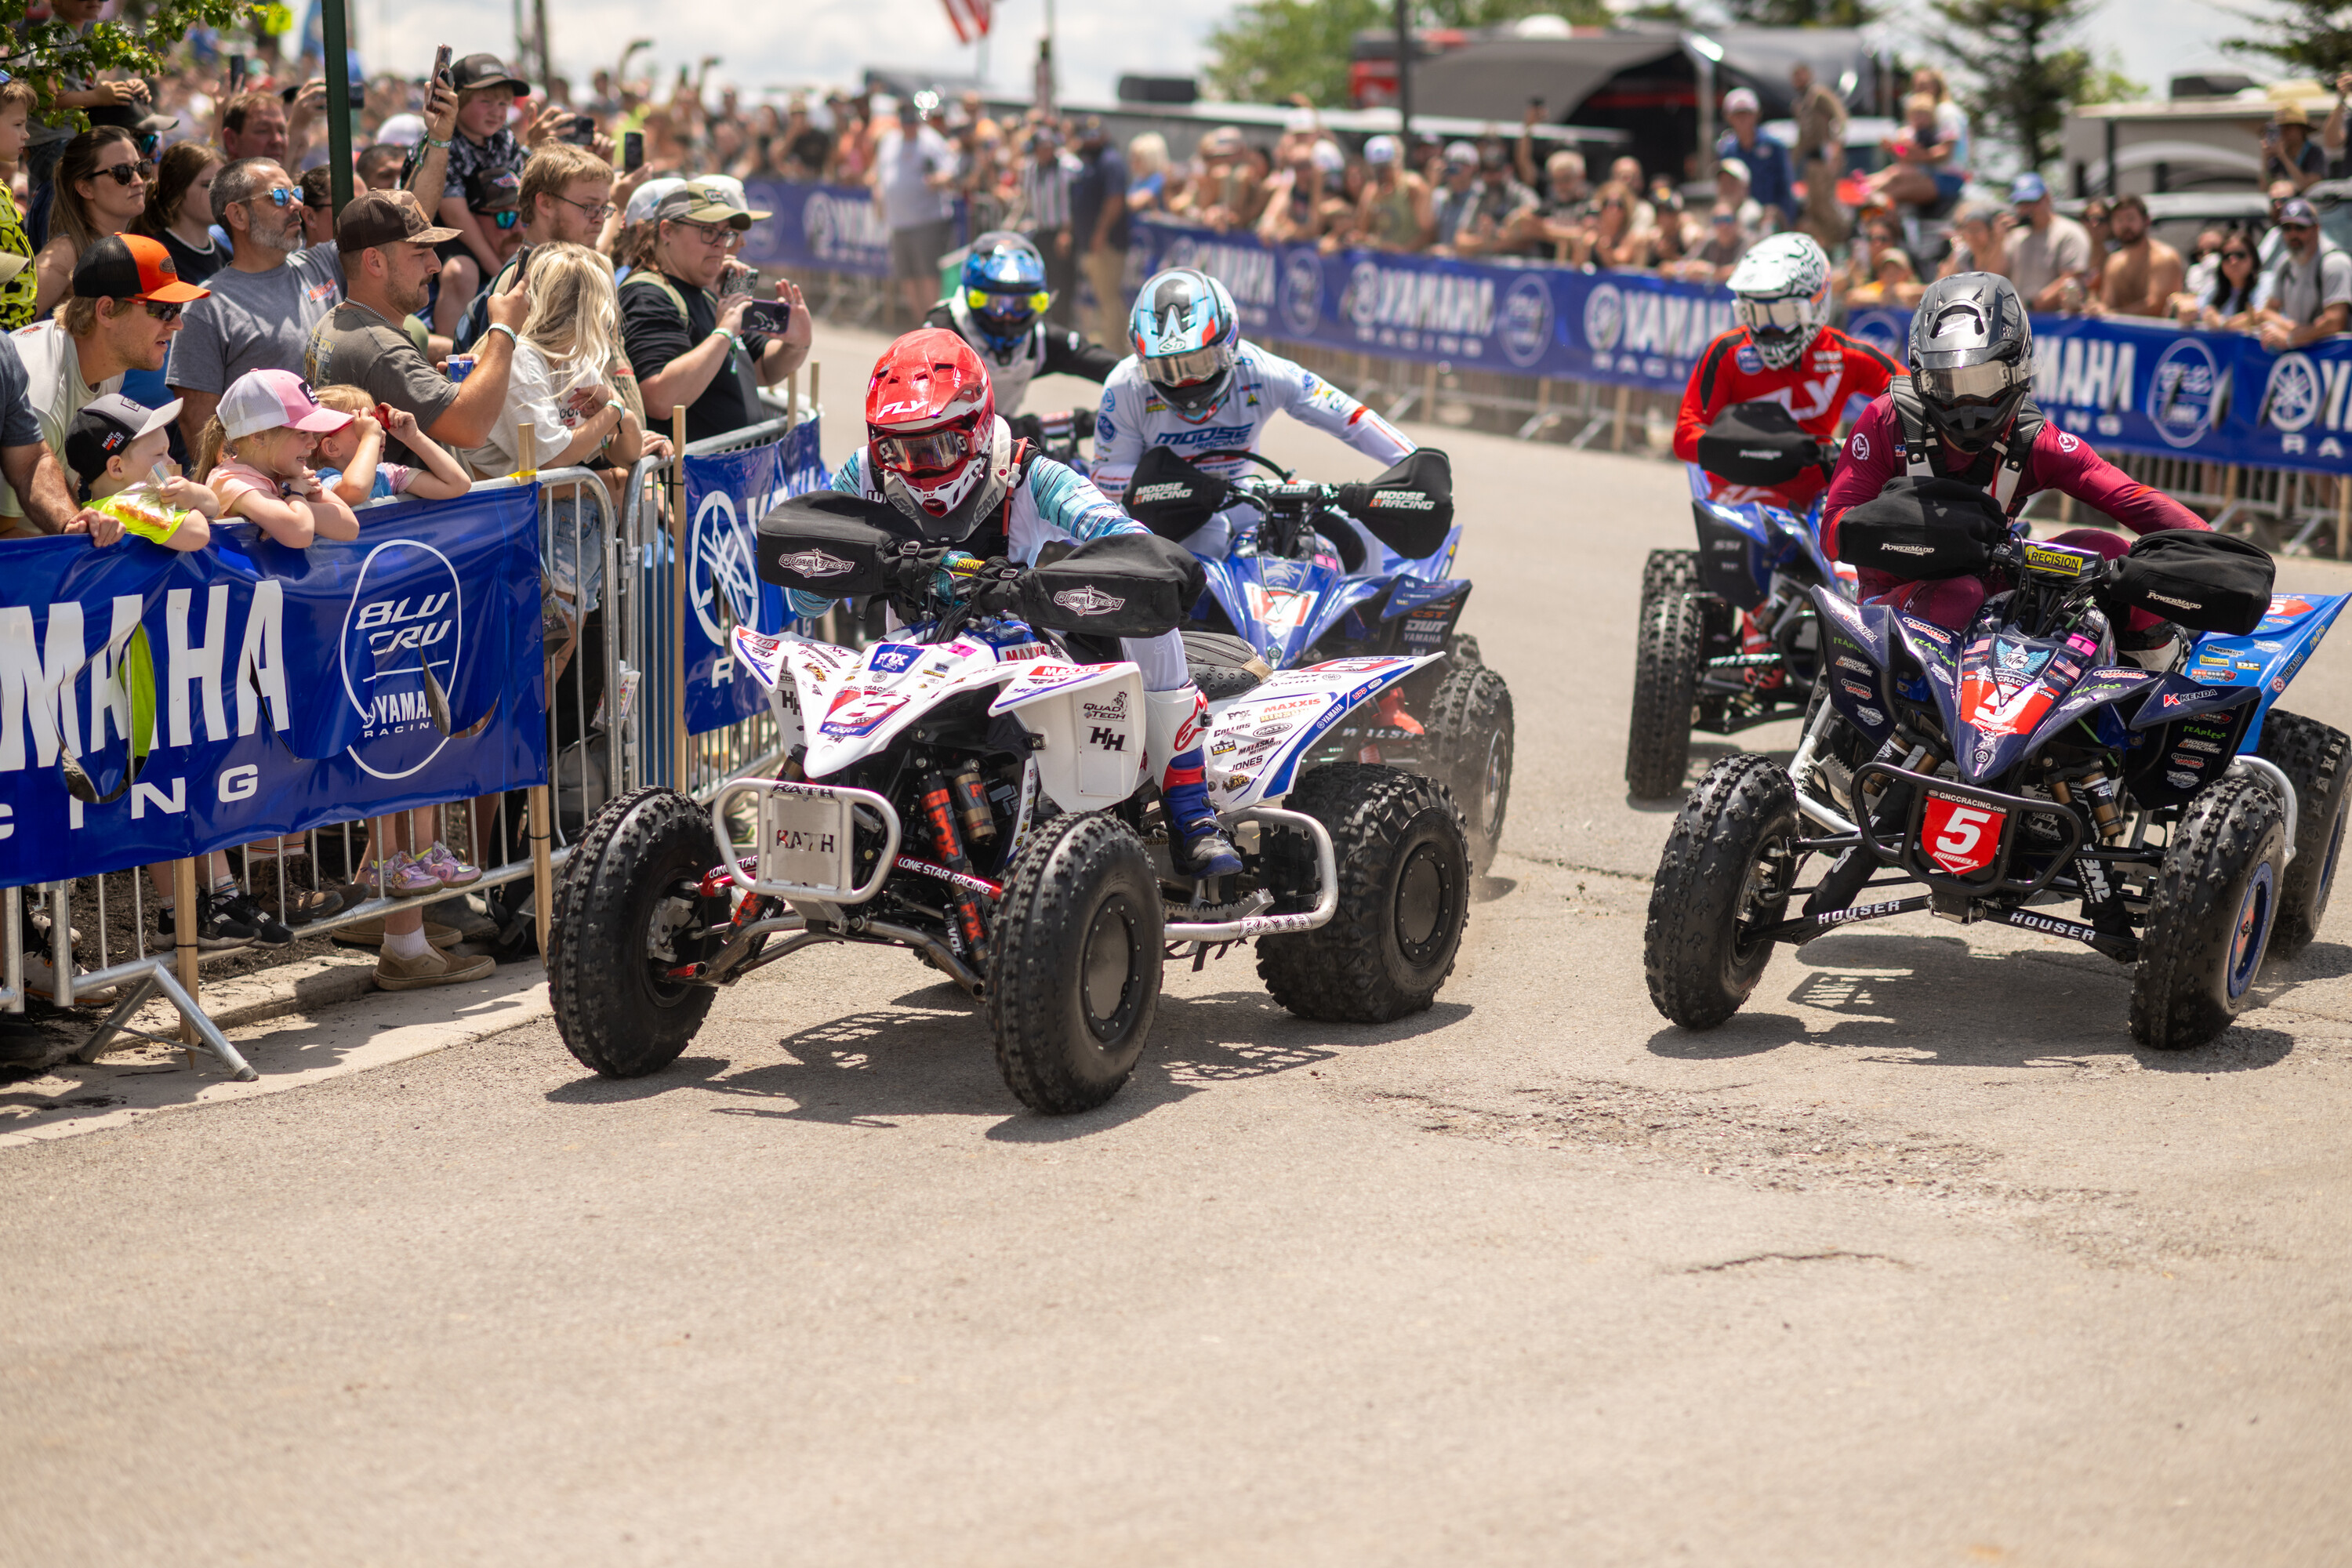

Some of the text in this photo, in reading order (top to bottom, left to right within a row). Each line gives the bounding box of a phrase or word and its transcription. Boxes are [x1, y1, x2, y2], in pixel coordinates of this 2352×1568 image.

[1622, 289, 1734, 359] YAMAH
[877, 400, 930, 419] FLY
[102, 431, 115, 448] READY
[113, 434, 125, 448] RACE
[1155, 423, 1255, 445] MOOSE
[1136, 481, 1184, 496] MOOSE
[1141, 488, 1193, 503] RACING
[1374, 491, 1426, 501] MOOSE
[1379, 499, 1436, 510] RACING
[818, 560, 855, 572] TECH
[2027, 546, 2080, 569] PRECISION
[355, 591, 451, 630] BLU
[1091, 597, 1123, 608] TECH
[1412, 610, 1446, 619] CST
[1404, 619, 1449, 633] DWT
[1404, 632, 1442, 644] YAMAHA
[874, 652, 909, 666] FOX
[1839, 655, 1868, 670] MOOSE
[2281, 652, 2304, 681] TIREBALLS
[1842, 660, 1873, 677] RACING
[2180, 688, 2218, 703] KENDA
[1083, 702, 1122, 712] QUAD
[1264, 699, 1321, 713] MAXXIS
[1322, 703, 1345, 724] YAMAHA
[1092, 710, 1126, 720] TECH
[364, 720, 437, 739] RACIN
[2183, 725, 2226, 739] FEARLESS
[1087, 726, 1129, 752] HH
[1237, 737, 1276, 756] MALASKA
[2183, 739, 2218, 749] MOOSE
[2186, 744, 2222, 754] RACING
[1229, 755, 1264, 772] JONES
[771, 782, 837, 800] RATH
[1940, 792, 2007, 814] GNCCRACING.COM
[1936, 807, 1991, 855] 5
[776, 829, 834, 854] RATH
[898, 856, 993, 895] LONE STAR RACING
[1817, 900, 1900, 926] HOUSER
[1239, 913, 1312, 938] RATH
[2009, 912, 2096, 941] HOUSER
